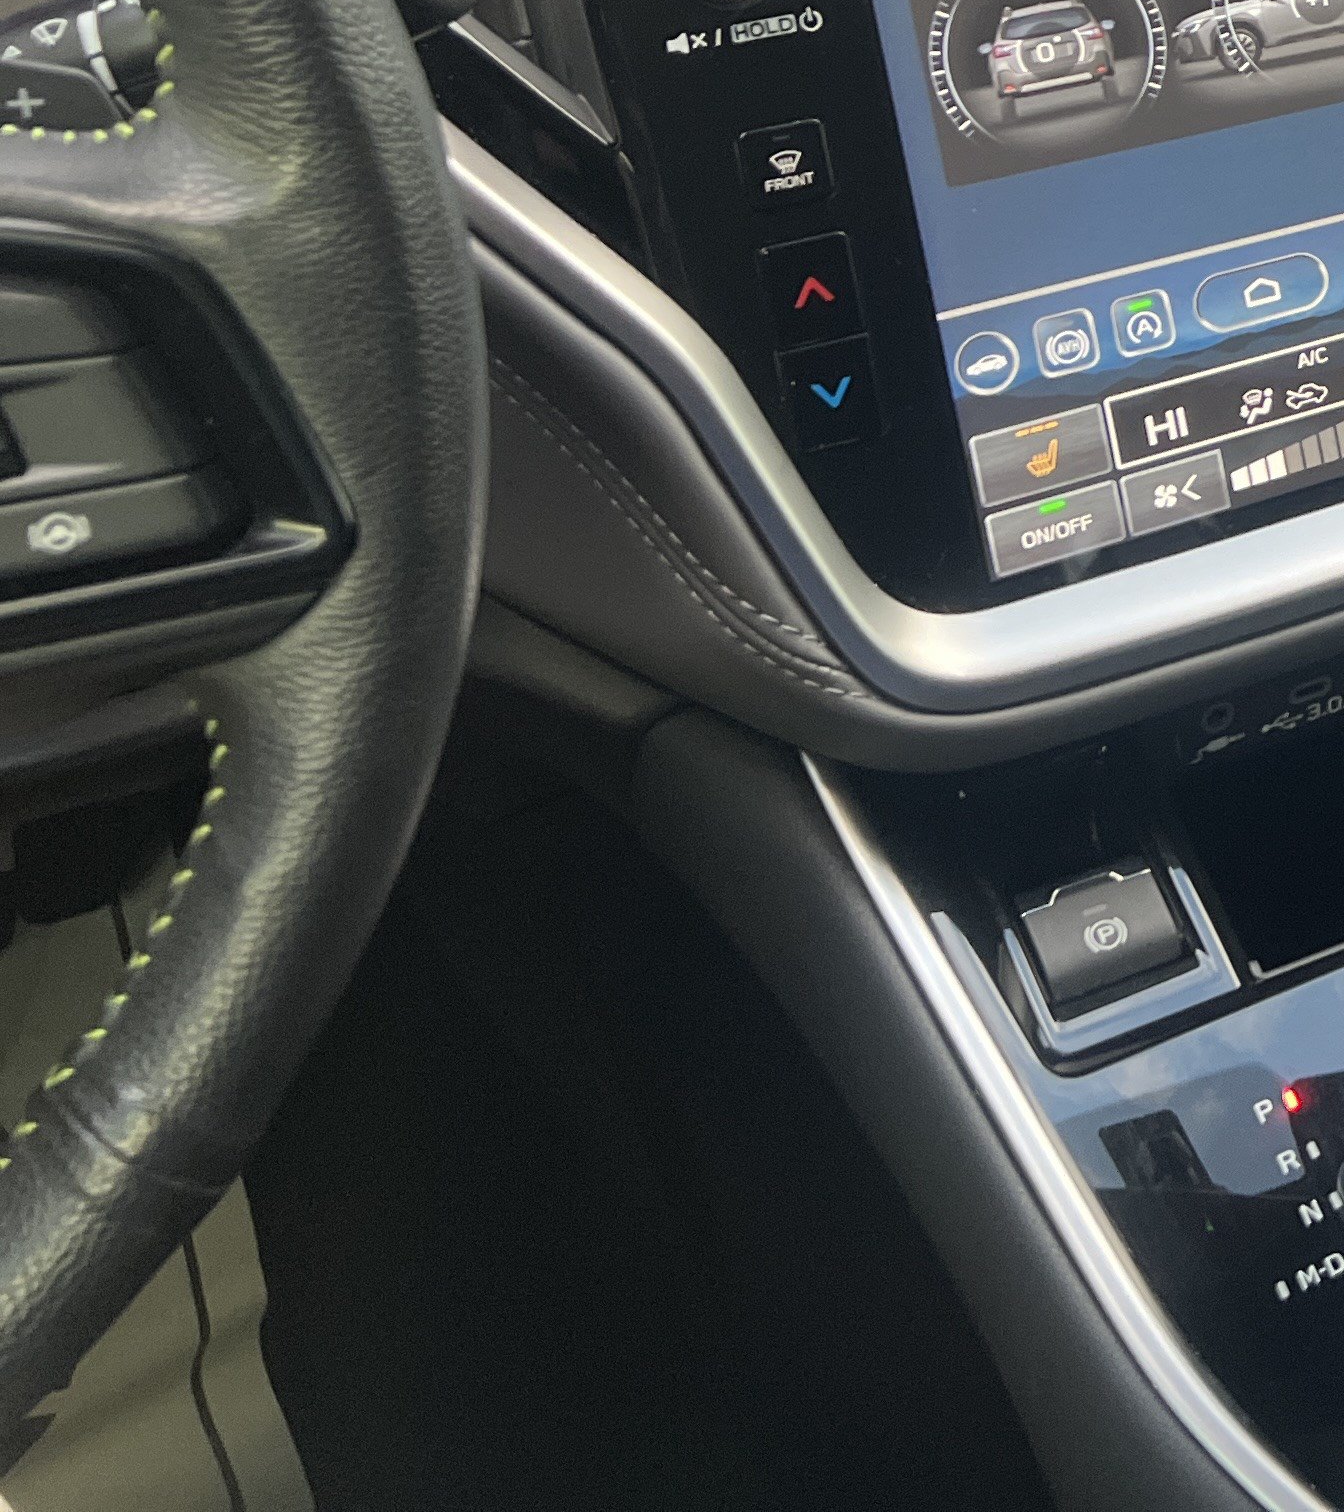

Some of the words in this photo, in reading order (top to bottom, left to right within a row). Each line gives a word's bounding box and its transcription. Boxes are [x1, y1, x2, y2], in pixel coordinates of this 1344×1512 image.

[733, 14, 796, 42] HOLD
[764, 171, 815, 193] FRONT
[1296, 346, 1329, 370] A/C
[1143, 405, 1189, 447] HI
[1020, 512, 1094, 551] ON/OFF
[1252, 1098, 1274, 1125] P
[1276, 1149, 1301, 1176] R
[1298, 1199, 1325, 1228] N
